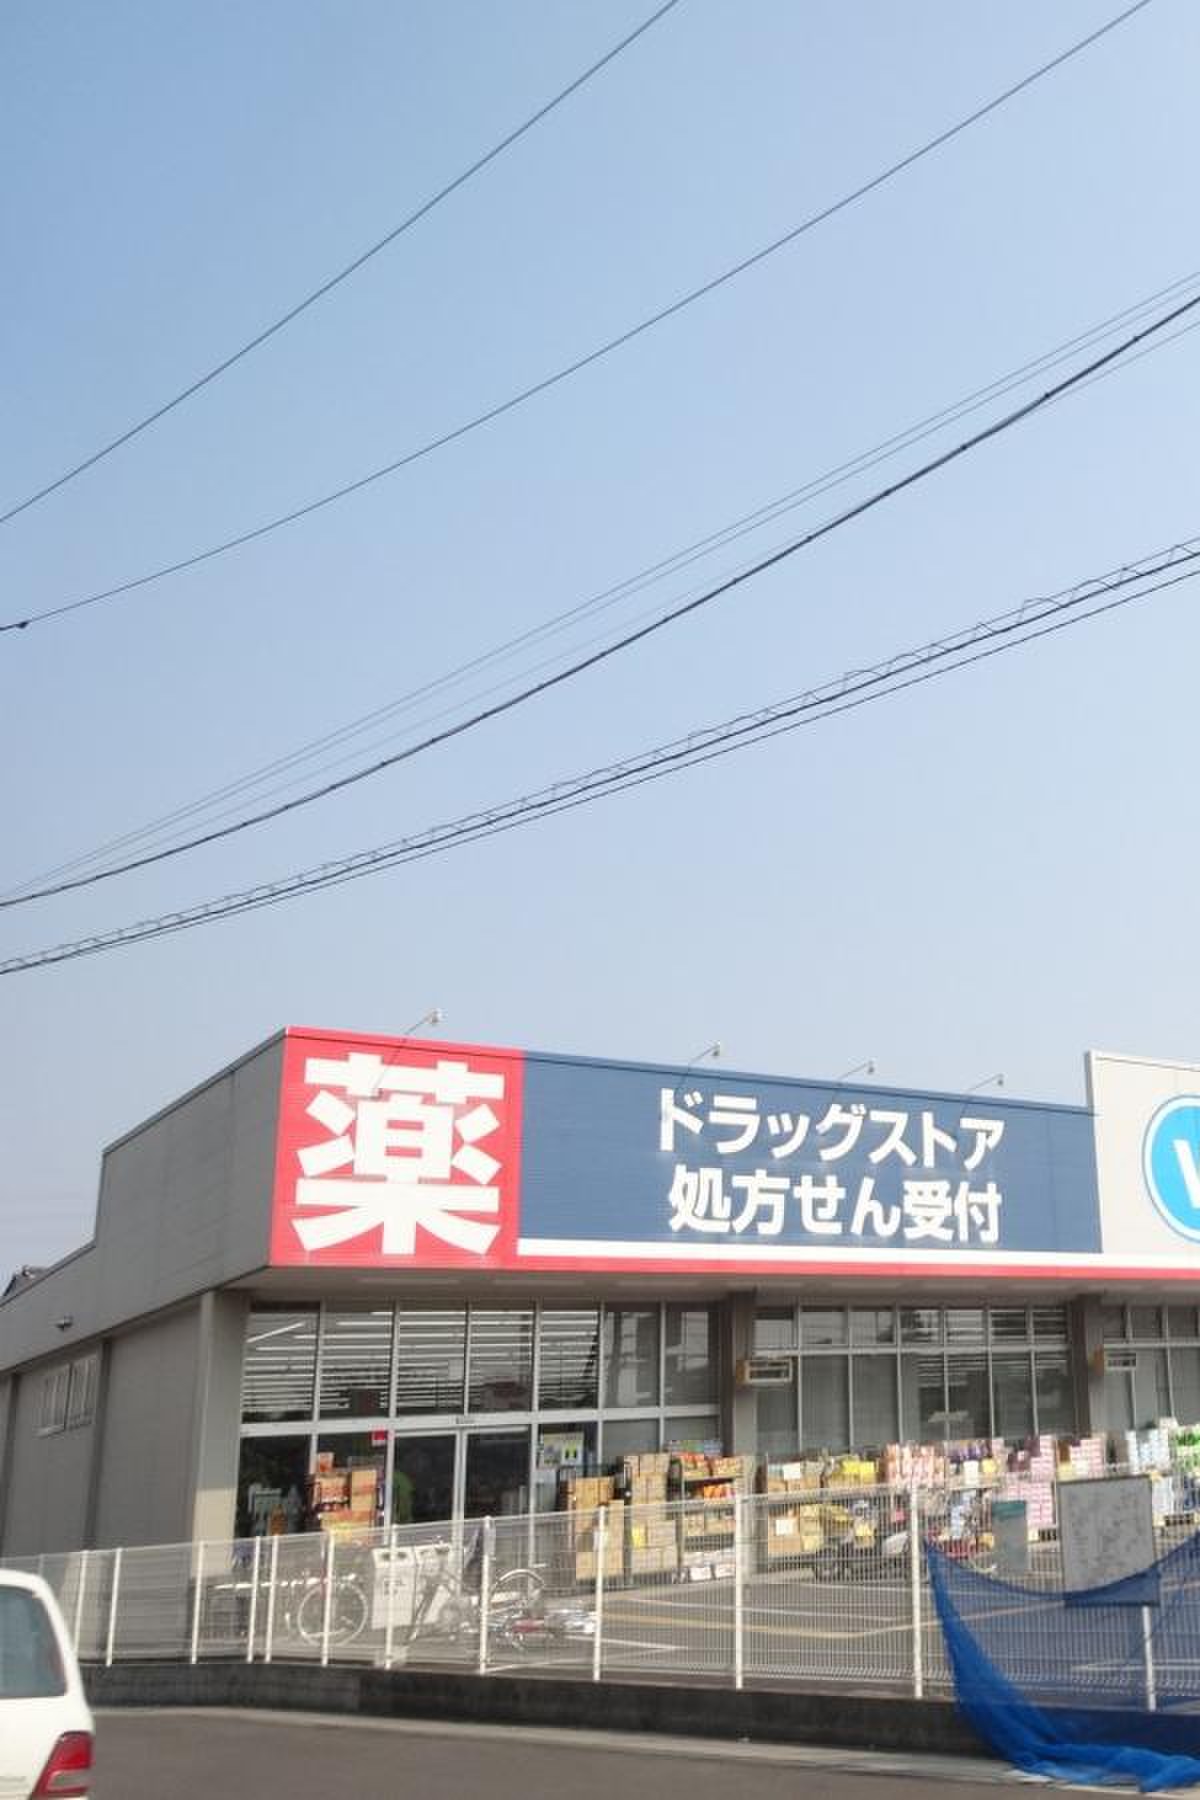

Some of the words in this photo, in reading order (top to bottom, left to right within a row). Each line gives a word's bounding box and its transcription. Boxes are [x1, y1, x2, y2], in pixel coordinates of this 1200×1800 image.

[291, 1051, 505, 1256] 薬
[659, 1086, 1005, 1173] ドラッグストア
[668, 1164, 1003, 1243] 処方せん受付
